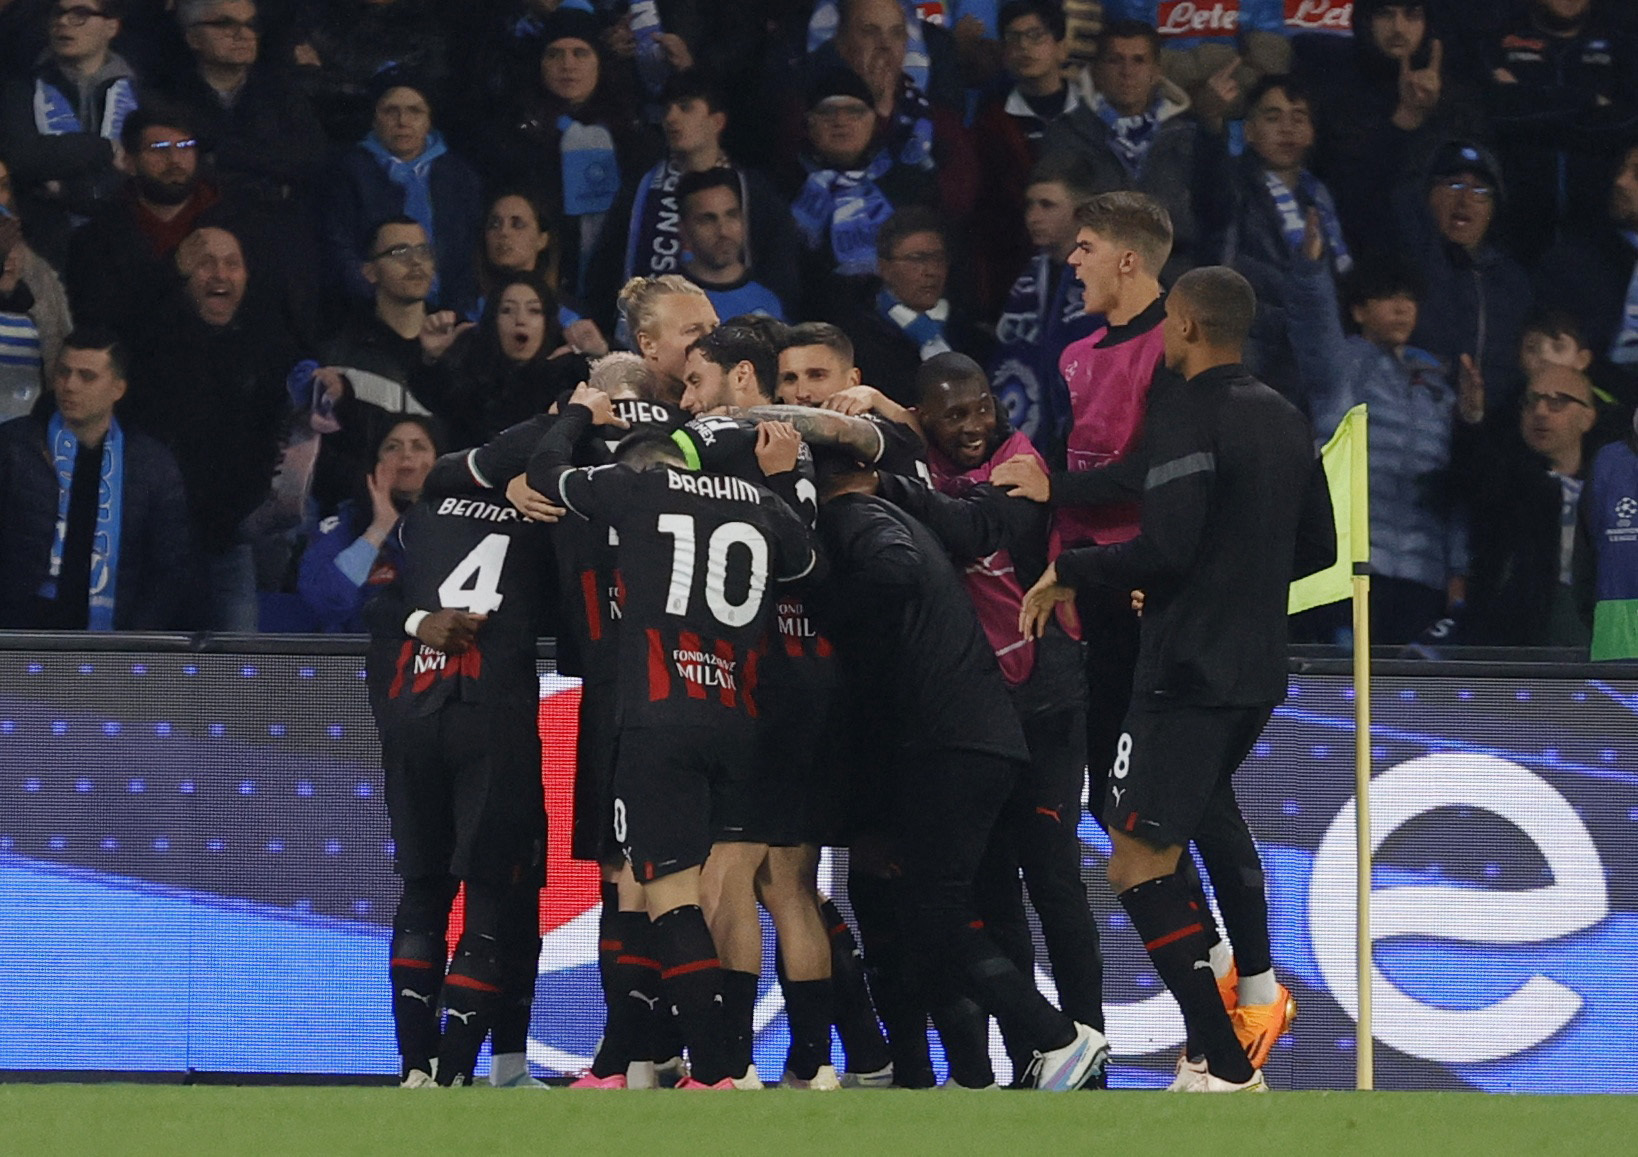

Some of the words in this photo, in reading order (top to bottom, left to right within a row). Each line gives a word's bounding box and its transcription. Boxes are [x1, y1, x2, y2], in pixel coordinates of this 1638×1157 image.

[1157, 2, 1239, 34] Lete
[612, 401, 669, 423] HEO
[667, 468, 760, 504] BRAHIM
[437, 497, 534, 522] BENNA
[438, 532, 510, 616] 4
[658, 513, 768, 627] 10
[675, 662, 737, 691] MILAN
[1110, 732, 1133, 779] 8
